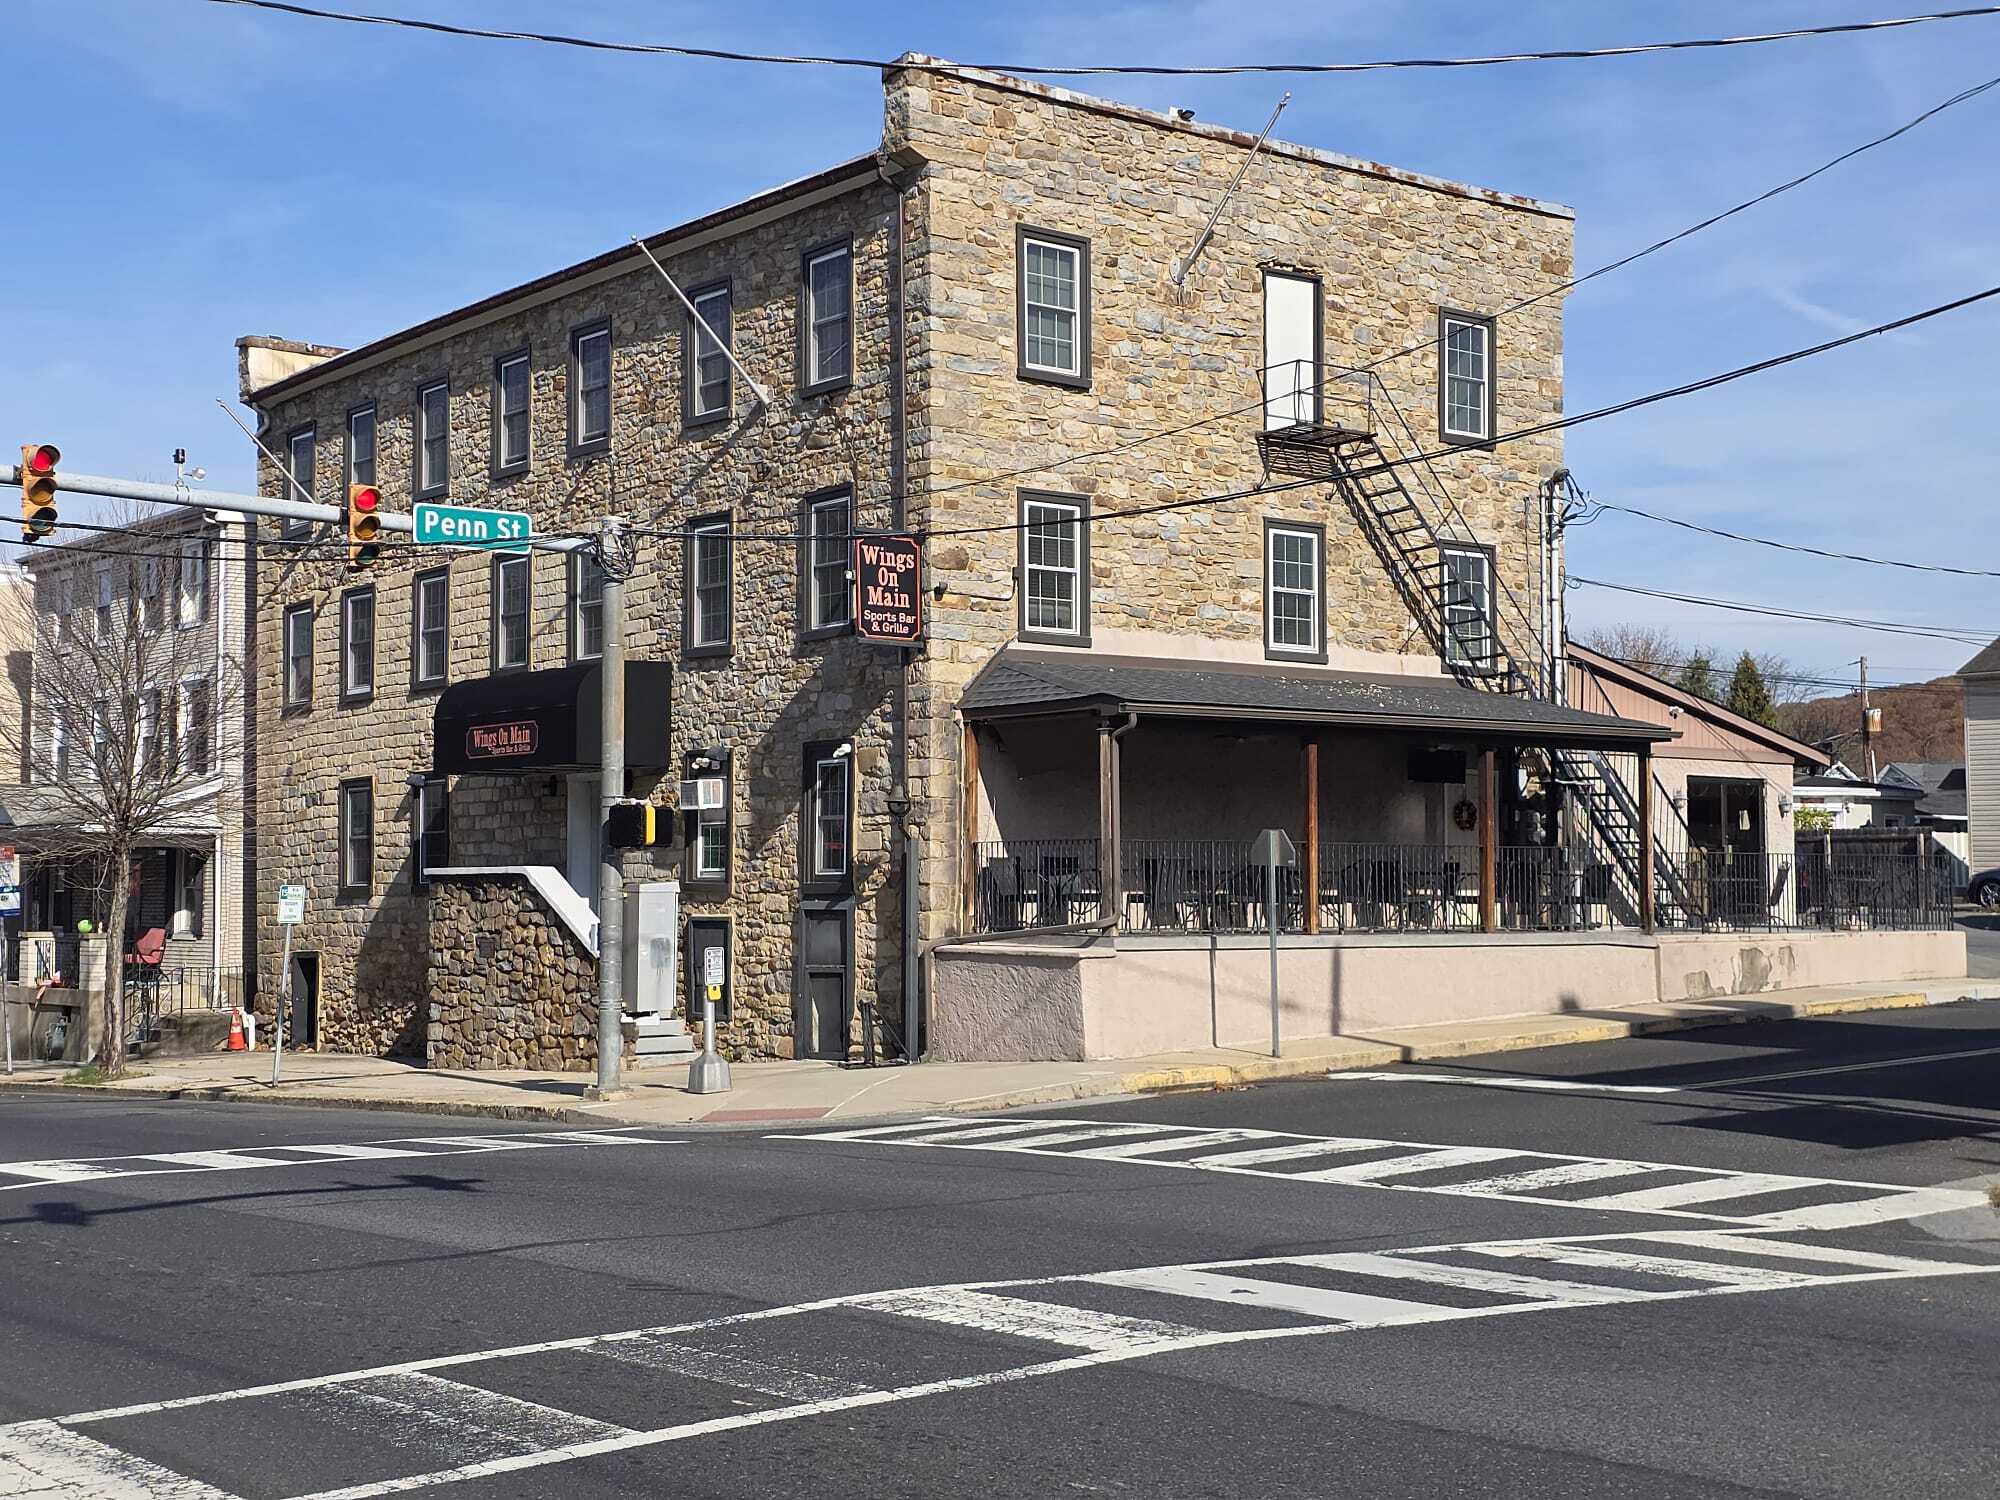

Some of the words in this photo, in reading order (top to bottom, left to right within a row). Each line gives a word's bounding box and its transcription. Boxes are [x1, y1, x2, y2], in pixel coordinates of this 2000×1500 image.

[424, 510, 488, 539] Penn
[497, 517, 521, 539] St
[861, 544, 915, 573] Wings
[878, 566, 900, 588] On
[867, 586, 911, 609] Main
[863, 609, 897, 622] Sports
[899, 612, 917, 624] Bar
[871, 621, 881, 632] &
[882, 622, 909, 634] Grille
[473, 729, 497, 749] Wings
[498, 727, 508, 746] On
[510, 725, 530, 745] Main
